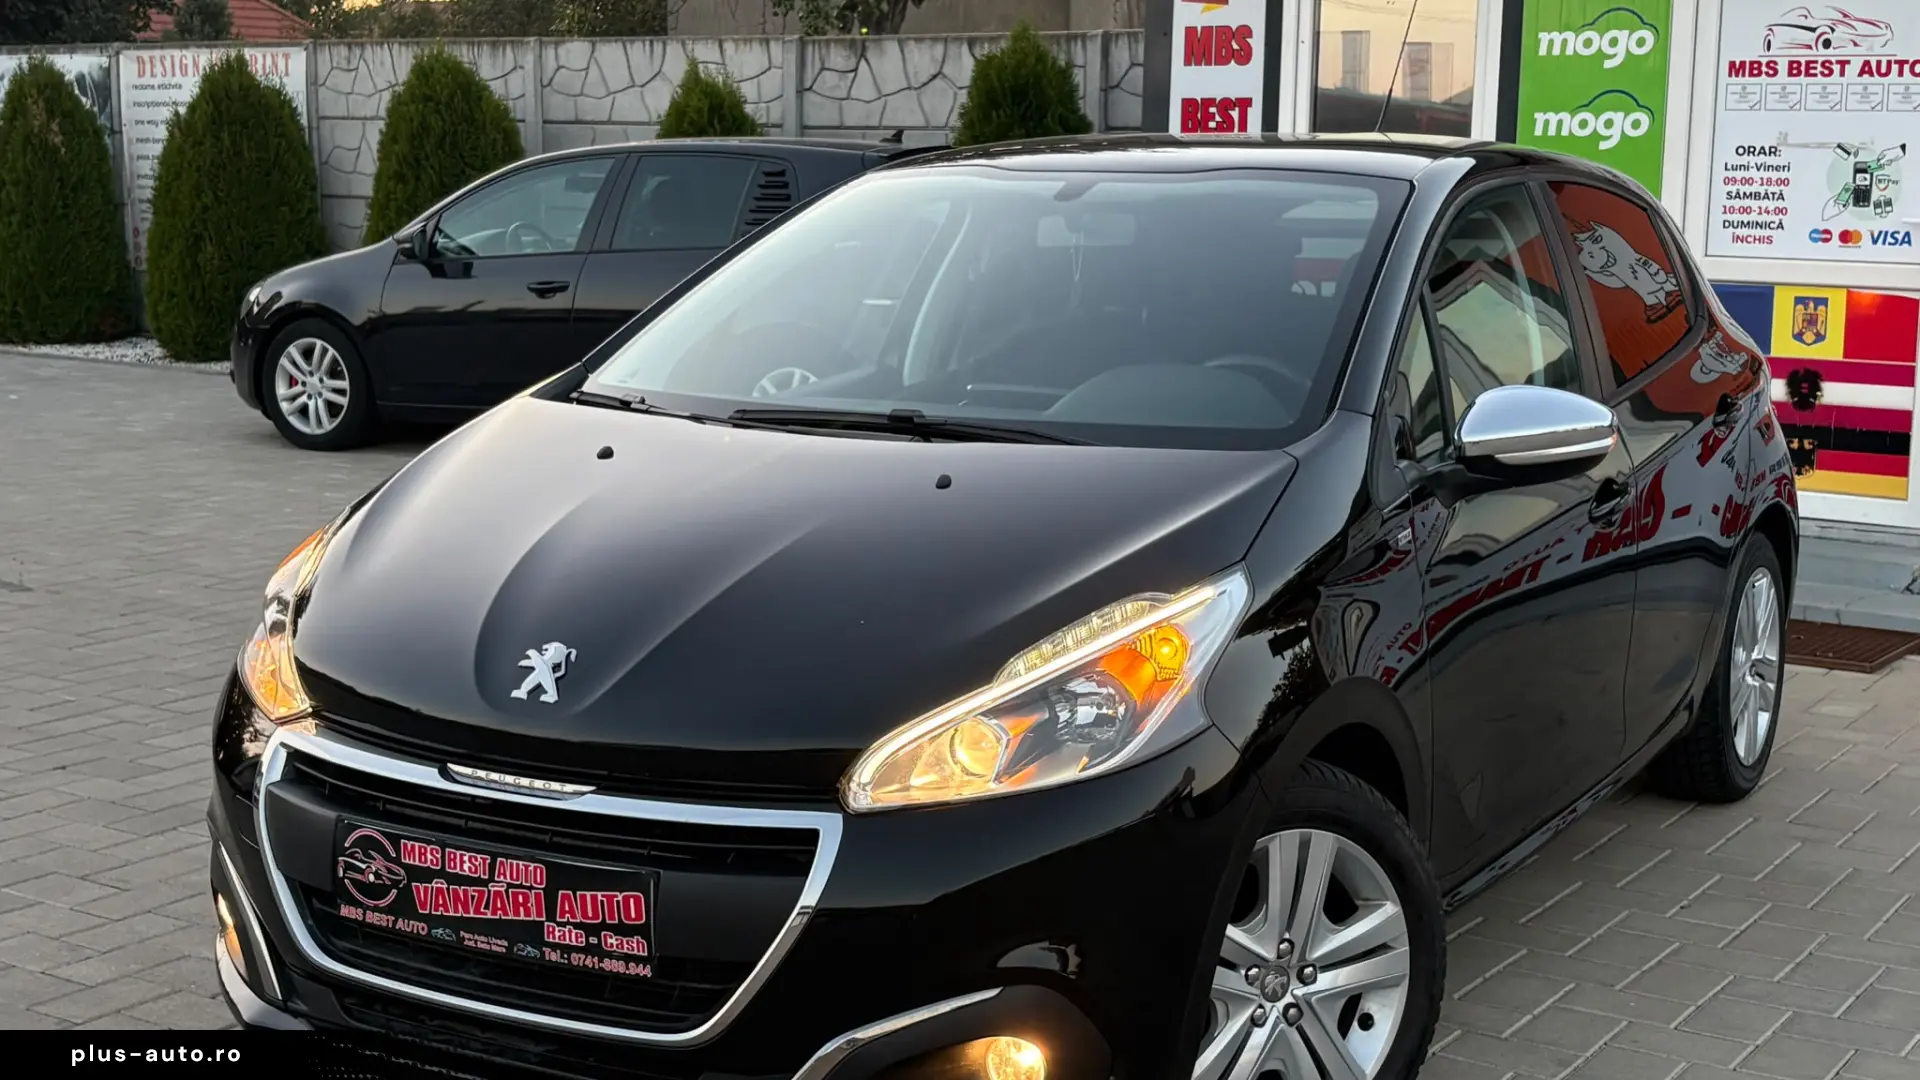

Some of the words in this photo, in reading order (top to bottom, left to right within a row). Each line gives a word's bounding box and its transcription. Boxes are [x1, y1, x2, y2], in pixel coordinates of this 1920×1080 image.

[1183, 24, 1253, 66] MBS
[1538, 29, 1655, 69] mogo
[136, 54, 200, 78] DESIGN
[248, 52, 291, 77] RINT
[1727, 60, 1779, 78] MBS
[1787, 60, 1851, 78] BEST
[1180, 97, 1253, 133] BEST
[1534, 111, 1650, 151] mogo
[1735, 145, 1782, 158] ORAR:
[1724, 161, 1791, 173] Luni-Vineri
[1723, 176, 1790, 187] 09:00-18:00
[1721, 205, 1789, 217] 10:00-14:00
[1722, 219, 1785, 231] DUMINICĂ
[1731, 231, 1774, 245] ÎNCHIS
[1869, 230, 1912, 247] VISA
[470, 769, 568, 791] PEUGEOT
[400, 839, 441, 870] MBS
[445, 847, 491, 880] BEST
[495, 858, 546, 888] AUTO
[411, 878, 546, 921] VÂNZĂRI
[556, 890, 646, 924] AUTO
[340, 904, 364, 921] MBS
[365, 911, 395, 929] BEST
[396, 917, 429, 936] AUTO
[544, 922, 586, 947] Rate
[601, 931, 648, 957] Cash
[543, 948, 569, 964] Tel.:
